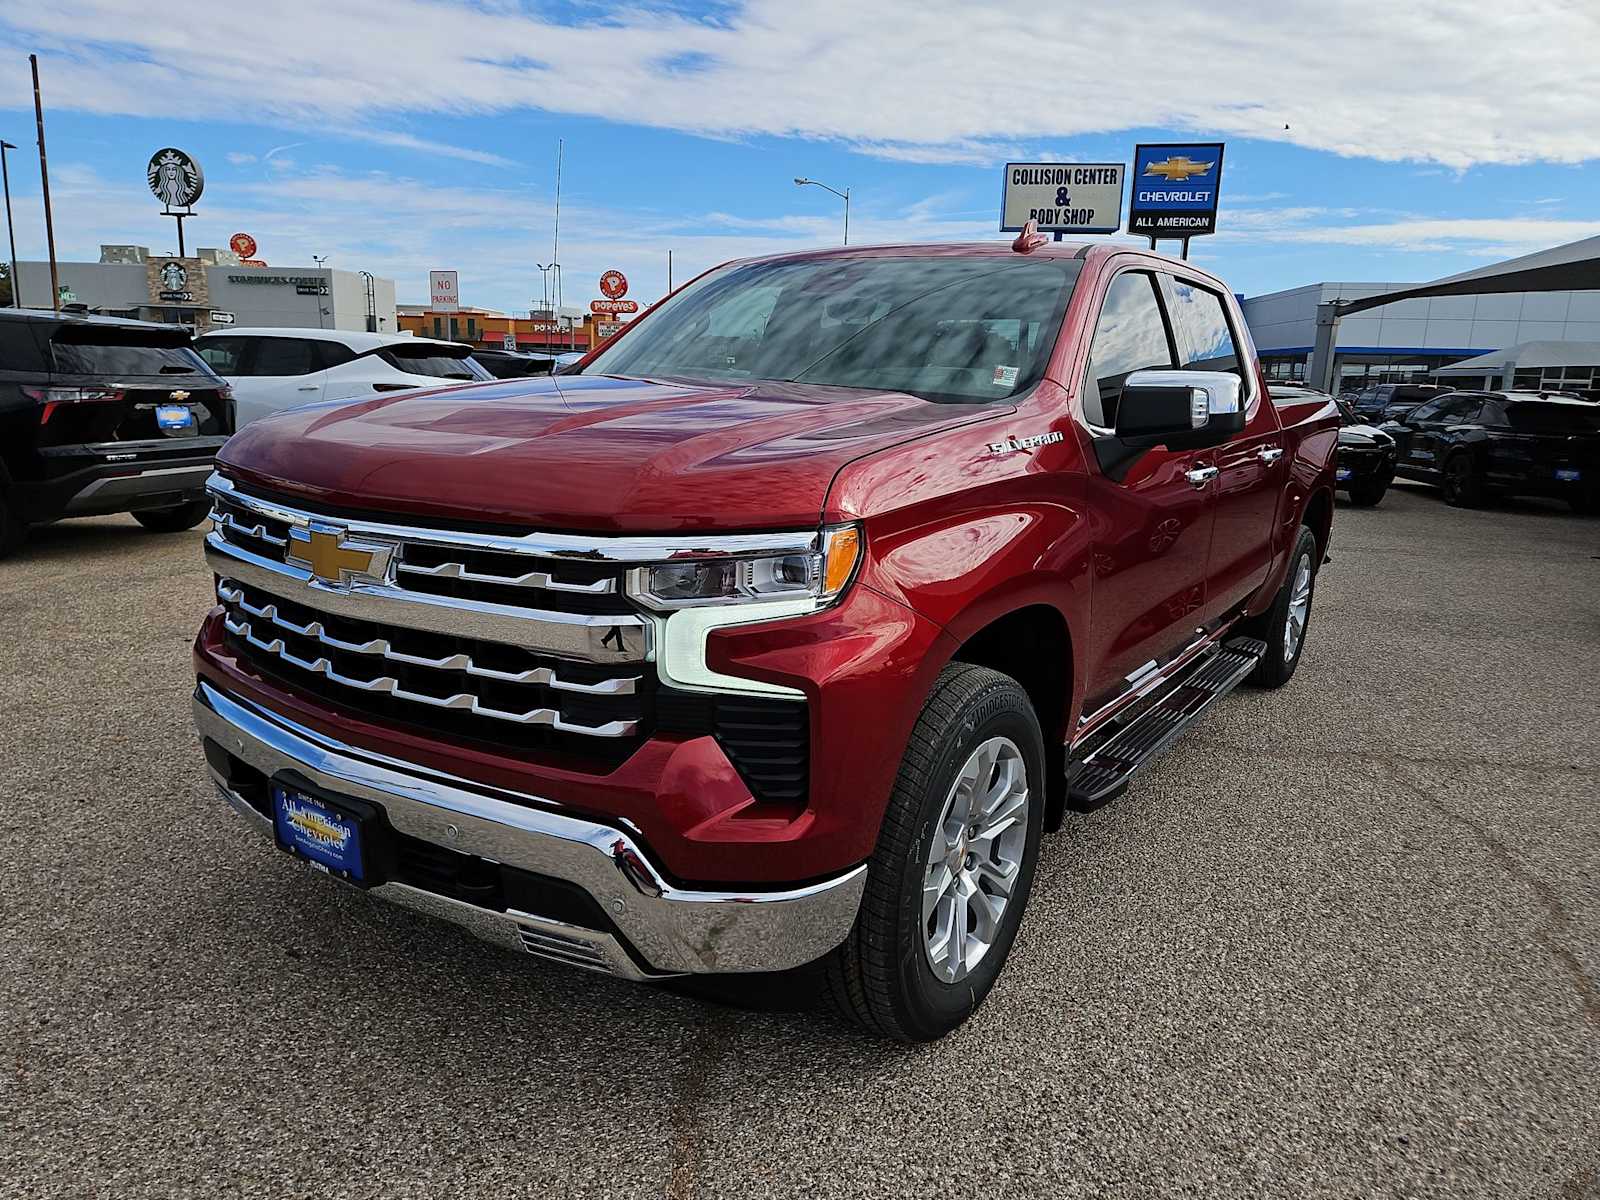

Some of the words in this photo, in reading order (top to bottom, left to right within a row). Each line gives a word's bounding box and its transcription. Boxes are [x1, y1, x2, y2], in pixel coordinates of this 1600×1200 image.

[1012, 168, 1071, 185] COLLISION
[1074, 168, 1117, 185] CENTER
[1055, 186, 1070, 207] &
[1139, 191, 1211, 202] CHEVROLET
[1029, 209, 1059, 225] BODY
[1063, 209, 1095, 225] SHOP
[1136, 217, 1154, 227] ALL
[1156, 217, 1210, 227] AMERICAN
[437, 280, 451, 290] NO
[432, 295, 457, 304] PARKING
